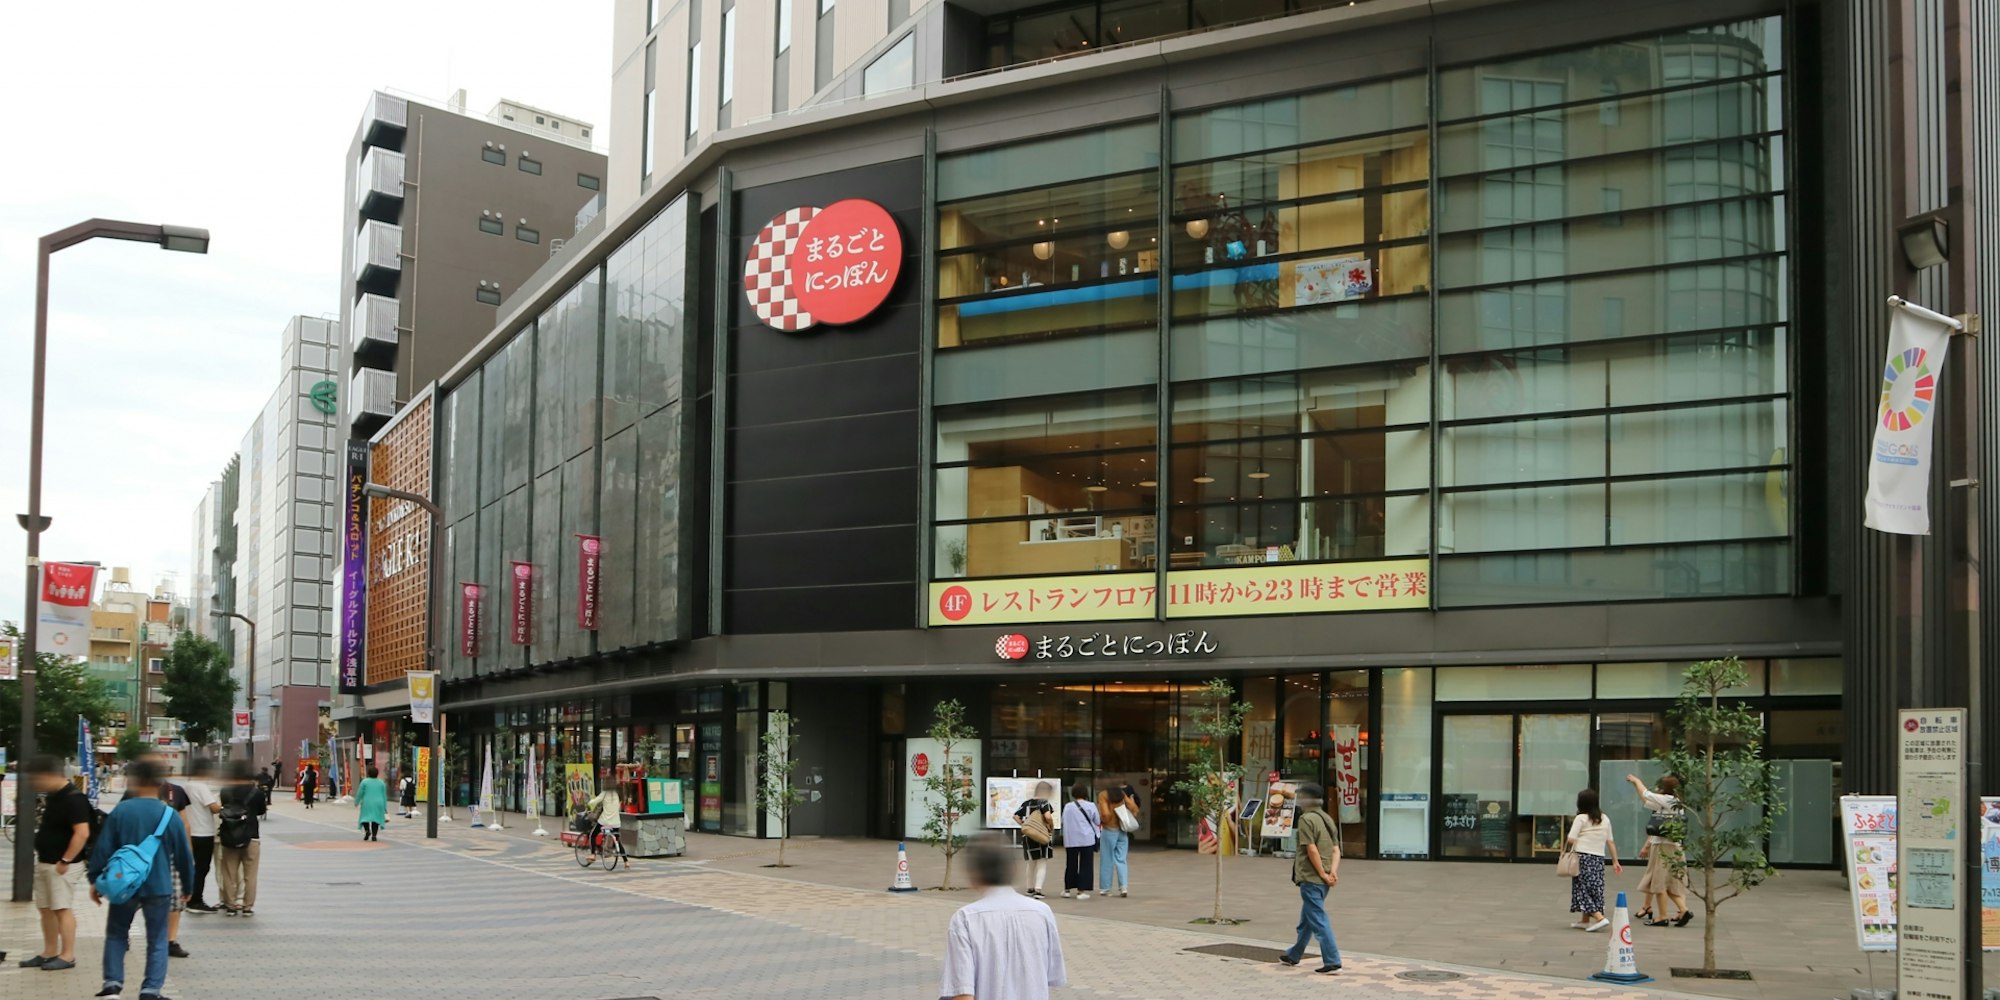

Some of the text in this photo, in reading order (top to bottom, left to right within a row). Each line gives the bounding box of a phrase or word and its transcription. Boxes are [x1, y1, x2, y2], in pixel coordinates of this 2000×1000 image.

[806, 227, 886, 263] まるごと
[804, 260, 889, 294] にっぽん
[584, 557, 596, 627] まるごとにっぽん
[944, 594, 967, 612] 4F
[982, 586, 1157, 613] レストランフロア
[1035, 629, 1219, 659] まるごとにっぽん
[1336, 737, 1358, 806] 甘酒
[1444, 815, 1477, 829] あまざけ
[1854, 812, 1896, 830] ふるさと
